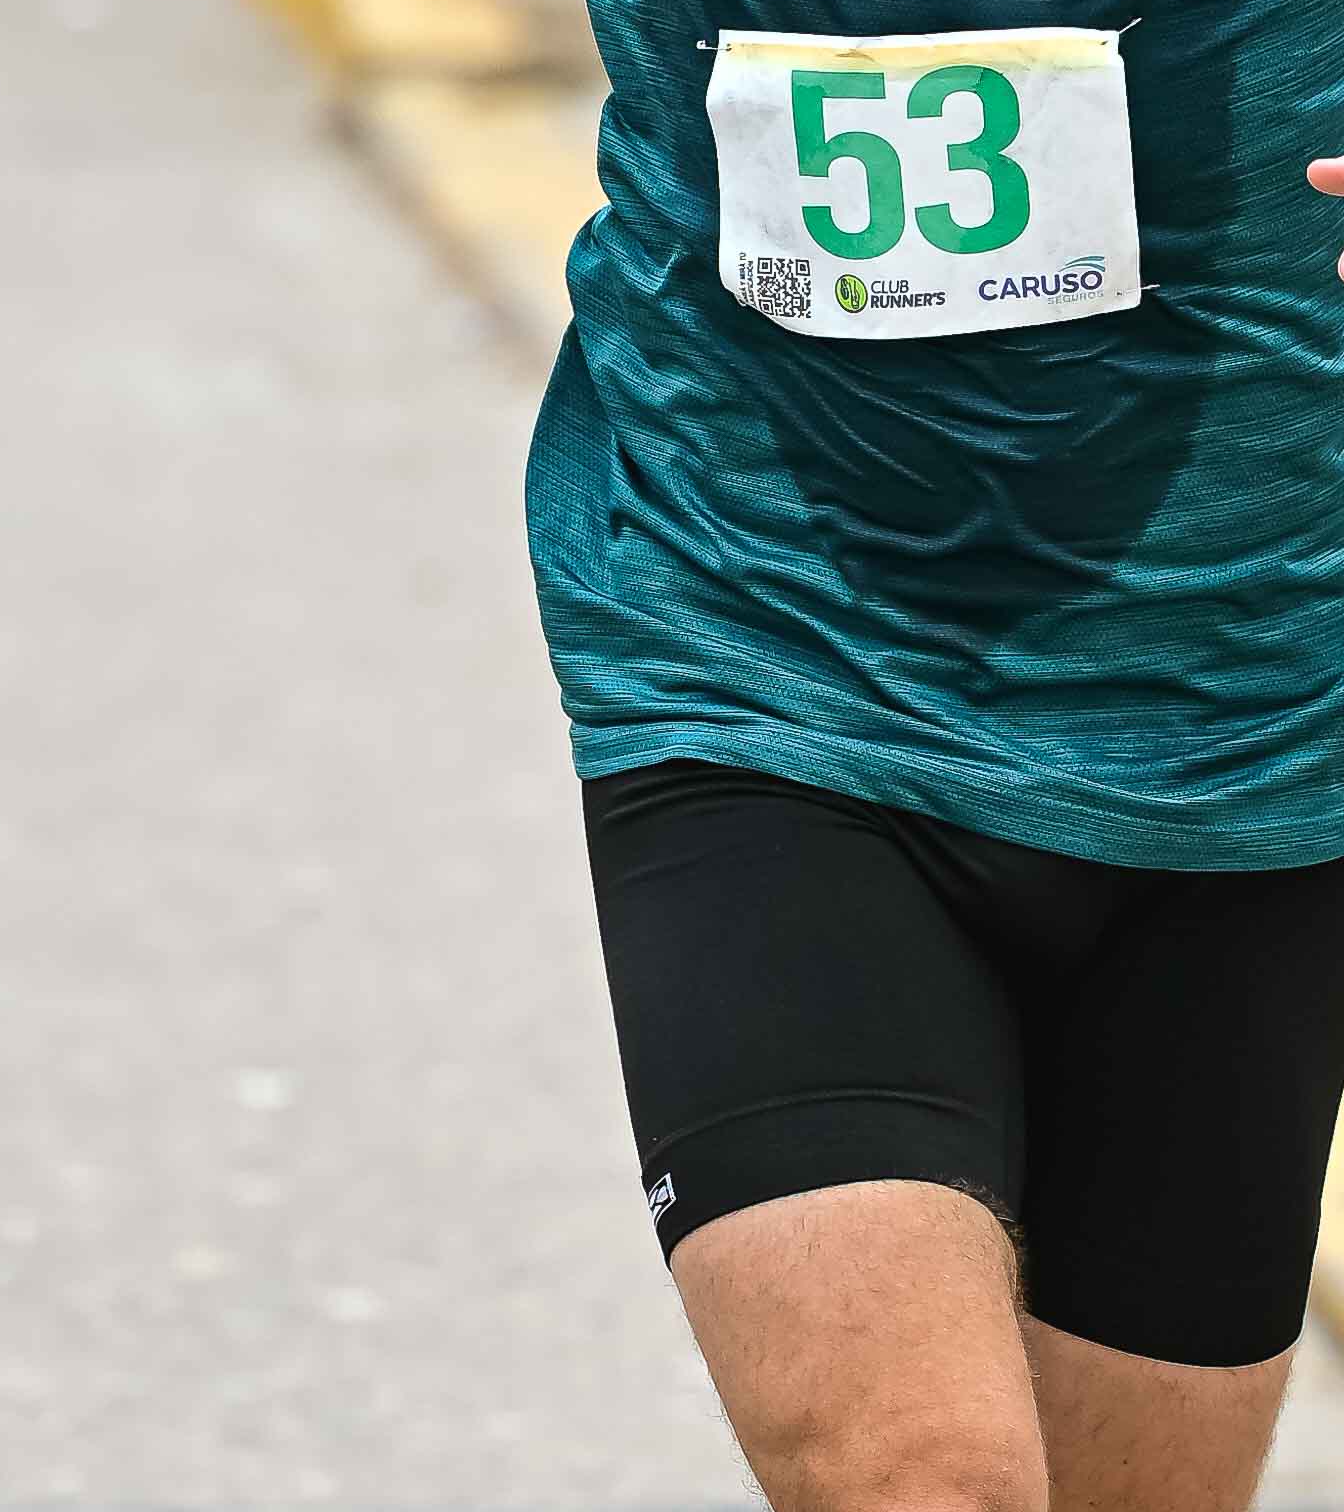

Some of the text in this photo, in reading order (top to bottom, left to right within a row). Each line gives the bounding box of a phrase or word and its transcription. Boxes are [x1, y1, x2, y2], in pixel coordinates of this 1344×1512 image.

[792, 65, 1030, 260] 53
[871, 280, 909, 294] CLUB
[978, 270, 1103, 301] CARUSO
[871, 292, 946, 308] RUNNER'S
[1047, 290, 1104, 305] SEGUROS
